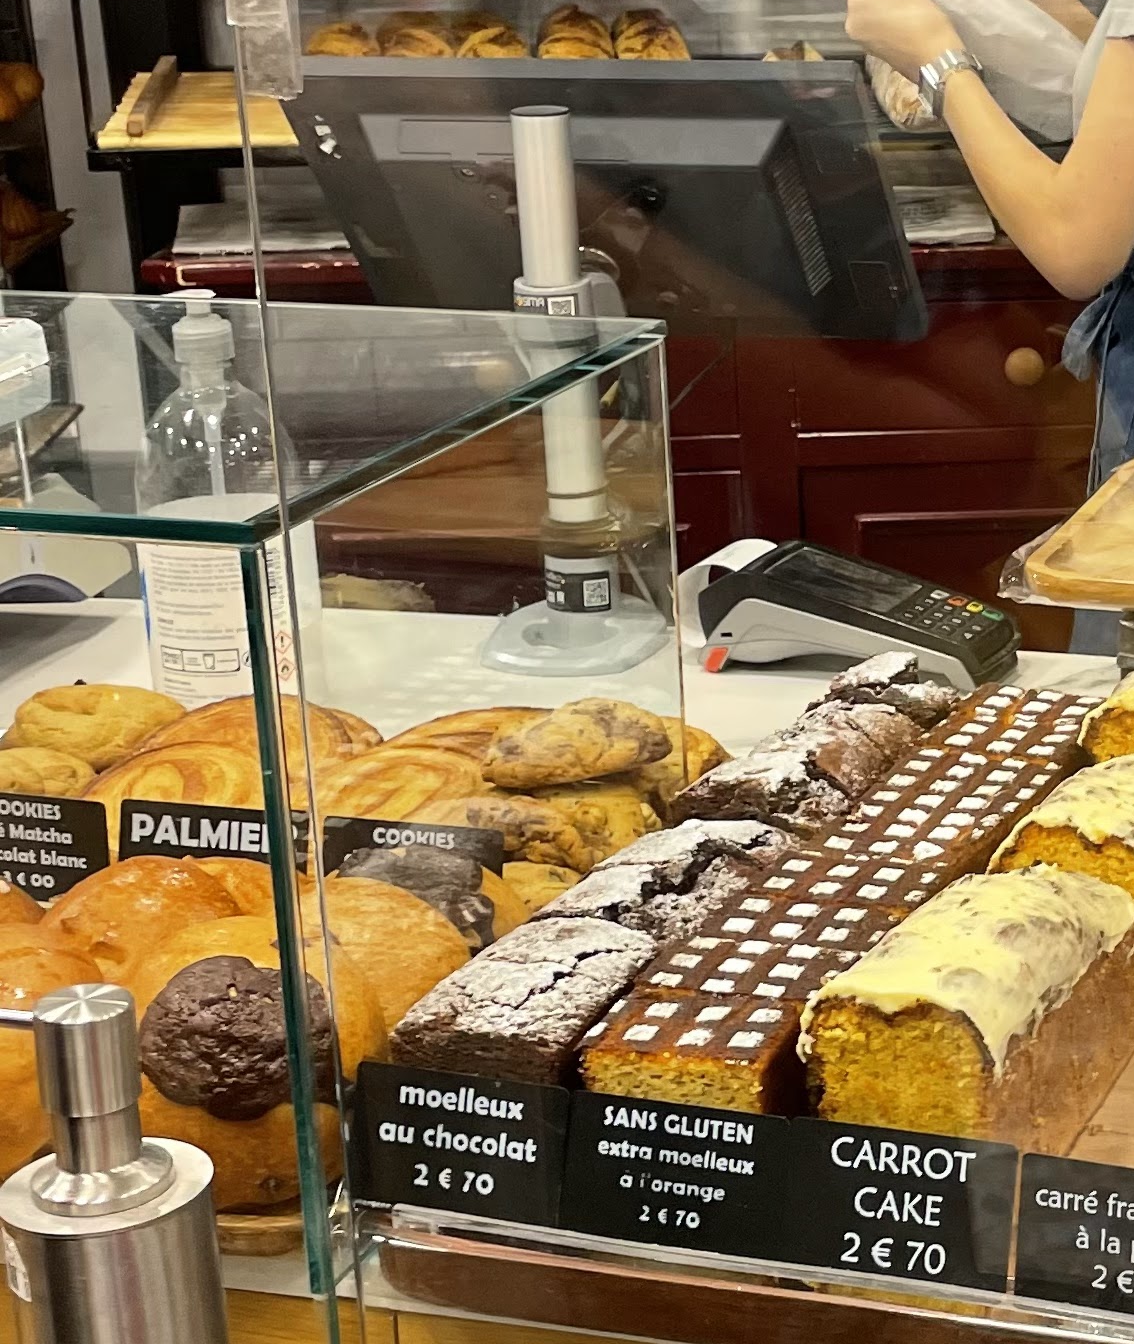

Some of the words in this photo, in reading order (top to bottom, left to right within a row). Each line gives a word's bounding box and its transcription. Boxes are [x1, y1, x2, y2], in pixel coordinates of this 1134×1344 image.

[0, 799, 61, 820] OOKIES
[9, 823, 73, 845] Matcha
[372, 826, 456, 850] COOKIES
[40, 849, 88, 869] blanc
[30, 873, 55, 888] 00
[400, 1085, 524, 1121] moelleux
[604, 1106, 657, 1132] SANS
[664, 1114, 753, 1144] GLUTEN
[379, 1122, 413, 1144] au
[423, 1124, 538, 1163] chocolat
[598, 1138, 652, 1161] extra
[659, 1145, 754, 1176] moelleux
[831, 1136, 977, 1183] CARROT
[413, 1163, 429, 1186] 2
[438, 1168, 452, 1189] €
[462, 1171, 495, 1196] 70
[854, 1186, 944, 1227] CAKE
[1035, 1188, 1098, 1214] carré
[639, 1205, 650, 1222] 2
[657, 1208, 668, 1224] €
[675, 1210, 700, 1229] 70
[840, 1232, 861, 1263] 2
[871, 1238, 894, 1268] €
[906, 1240, 946, 1275] 70
[1075, 1225, 1089, 1249] à
[1100, 1228, 1120, 1255] la
[1091, 1264, 1108, 1289] 2
[1116, 1269, 1134, 1294] €
